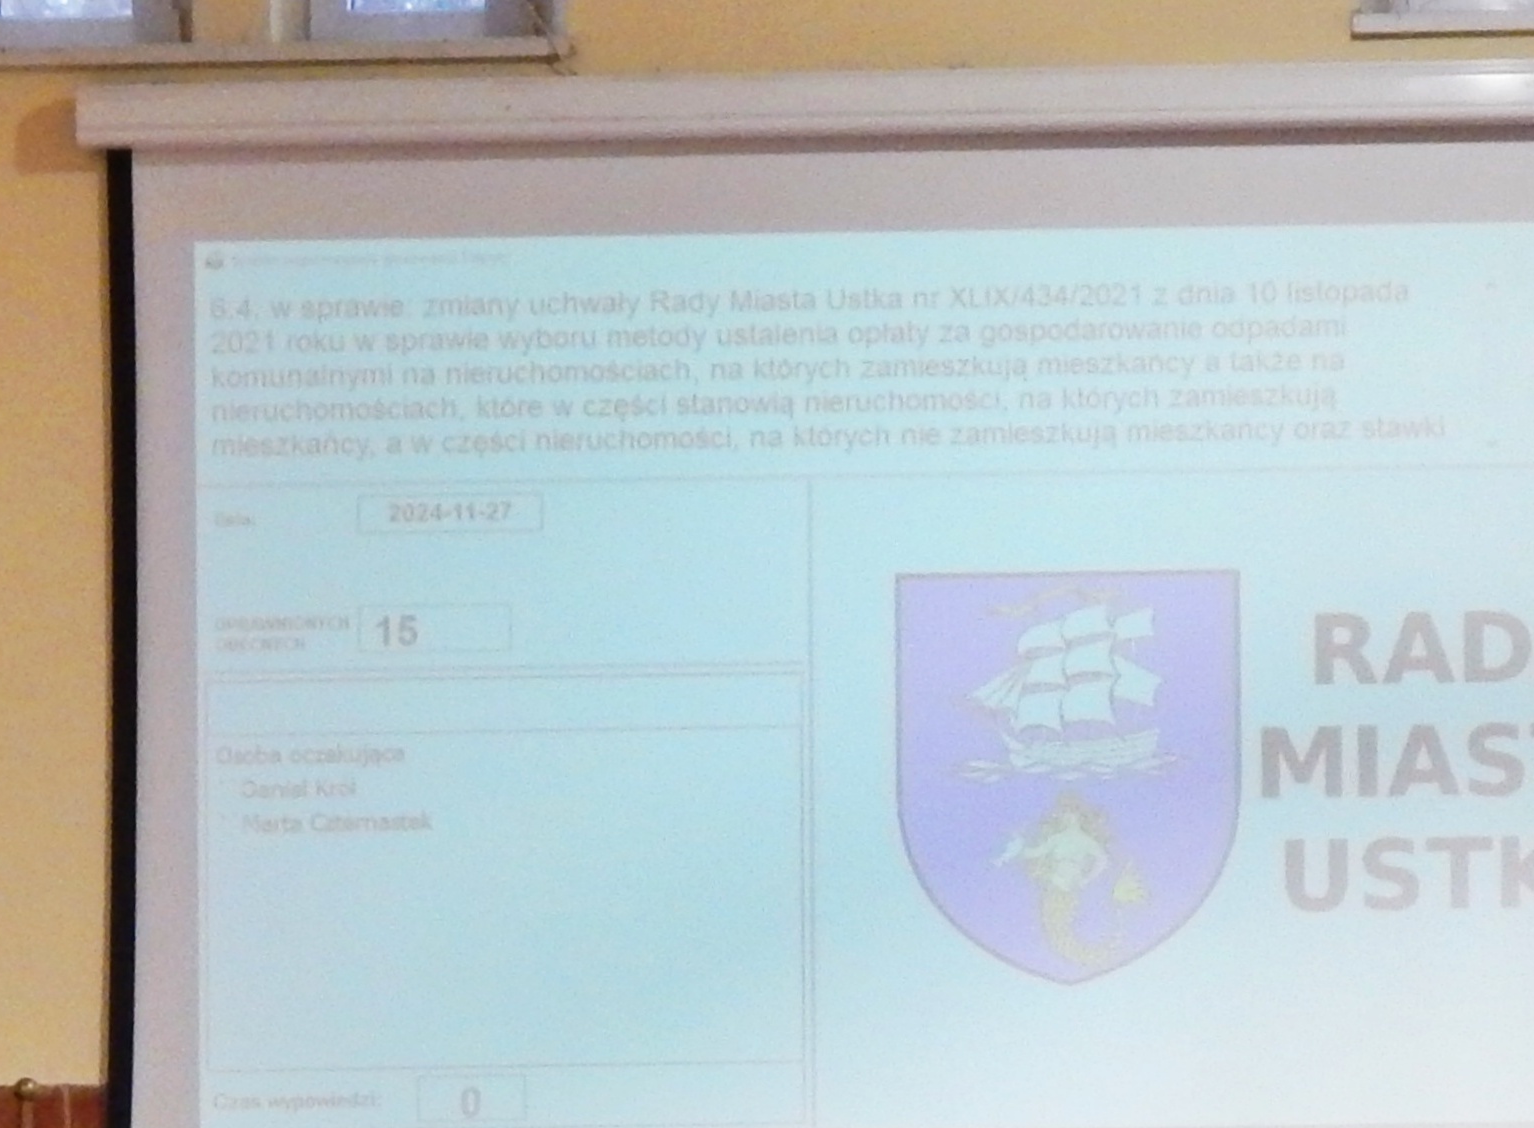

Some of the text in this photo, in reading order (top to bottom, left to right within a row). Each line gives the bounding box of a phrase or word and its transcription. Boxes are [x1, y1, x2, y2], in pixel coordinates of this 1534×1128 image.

[271, 302, 292, 319] w
[422, 296, 520, 321] zmiany
[528, 291, 641, 319] uchwały
[649, 289, 720, 318] Rady
[729, 287, 817, 313] Miasta
[825, 286, 903, 312] Ustka
[912, 290, 940, 310] nr
[1151, 288, 1168, 308] z
[1176, 282, 1237, 307] dnia
[1286, 279, 1410, 309] listopada
[210, 315, 1348, 357] 2021 roku w sprawie wyboru metody ustalenia opłaty za gospodarowanie odpadami
[210, 362, 393, 391] komunalnymi
[402, 366, 436, 386] na
[710, 362, 744, 381] na
[752, 356, 851, 387] których
[860, 355, 1028, 383] zamieszkują
[1037, 351, 1197, 380] mieszkańcy
[1204, 354, 1221, 373] a
[1230, 349, 1303, 373] także
[1311, 354, 1346, 373] na
[475, 393, 543, 419] które
[552, 400, 574, 418] w
[581, 392, 668, 422] części
[676, 391, 796, 420] stanowią
[1018, 394, 1052, 412] na
[1060, 386, 1161, 415] których
[1167, 384, 1339, 412] zamieszkują
[385, 437, 403, 456] a
[410, 436, 434, 455] w
[441, 429, 526, 458] części
[749, 430, 784, 449] na
[793, 424, 890, 454] których
[900, 424, 942, 447] nie
[949, 421, 1119, 451] zamieszkują
[1125, 418, 1285, 447] mieszkańcy
[1292, 420, 1353, 442] oraz
[1362, 414, 1447, 440] stawki
[388, 501, 514, 524] 2024-11-27
[375, 614, 420, 648] 15
[460, 1086, 482, 1120] 0
